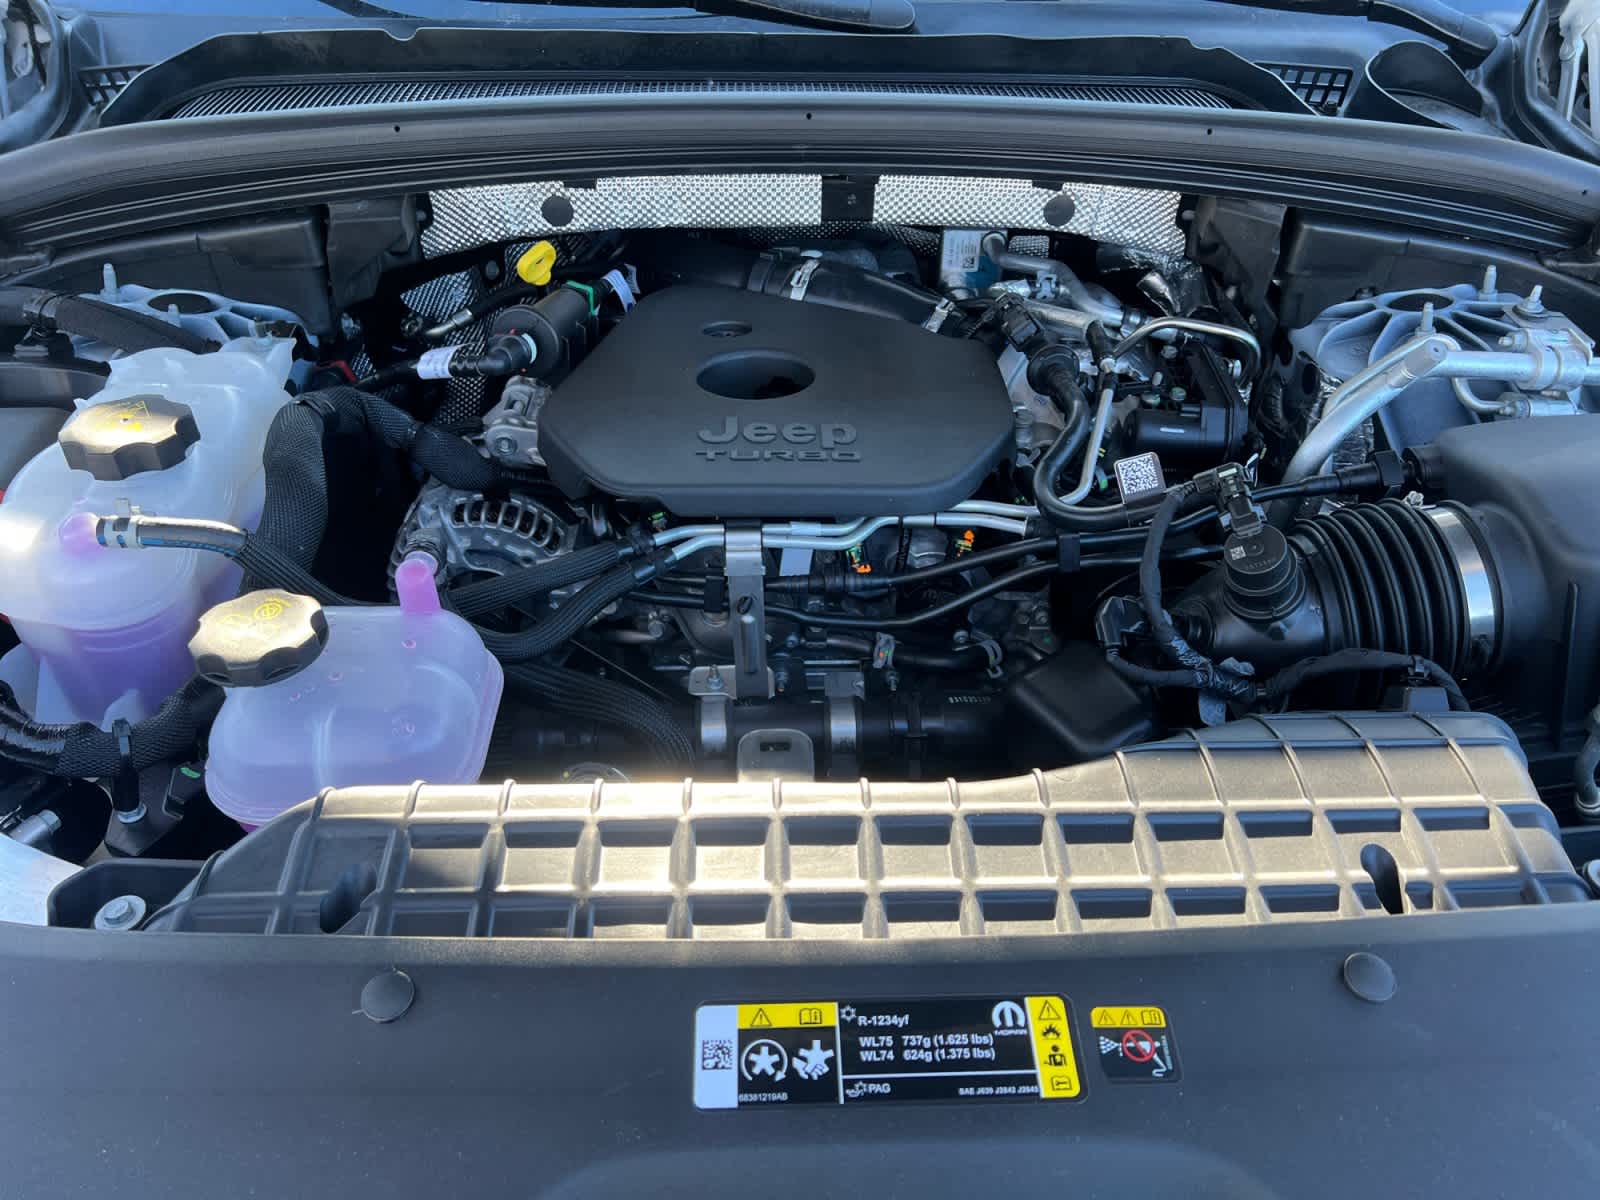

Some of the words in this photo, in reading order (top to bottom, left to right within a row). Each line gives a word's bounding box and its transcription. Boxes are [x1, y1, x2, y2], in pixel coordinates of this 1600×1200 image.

[697, 416, 857, 450] Jeep
[696, 449, 862, 463] TURBO
[857, 1014, 910, 1028] R-1234yf
[859, 1036, 893, 1048] WL75
[902, 1035, 931, 1048] 737g
[971, 1033, 994, 1046] lbs)
[860, 1050, 894, 1062] WL74
[903, 1049, 932, 1063] 624g
[973, 1048, 996, 1060] lbs)
[868, 1083, 891, 1094] PAG
